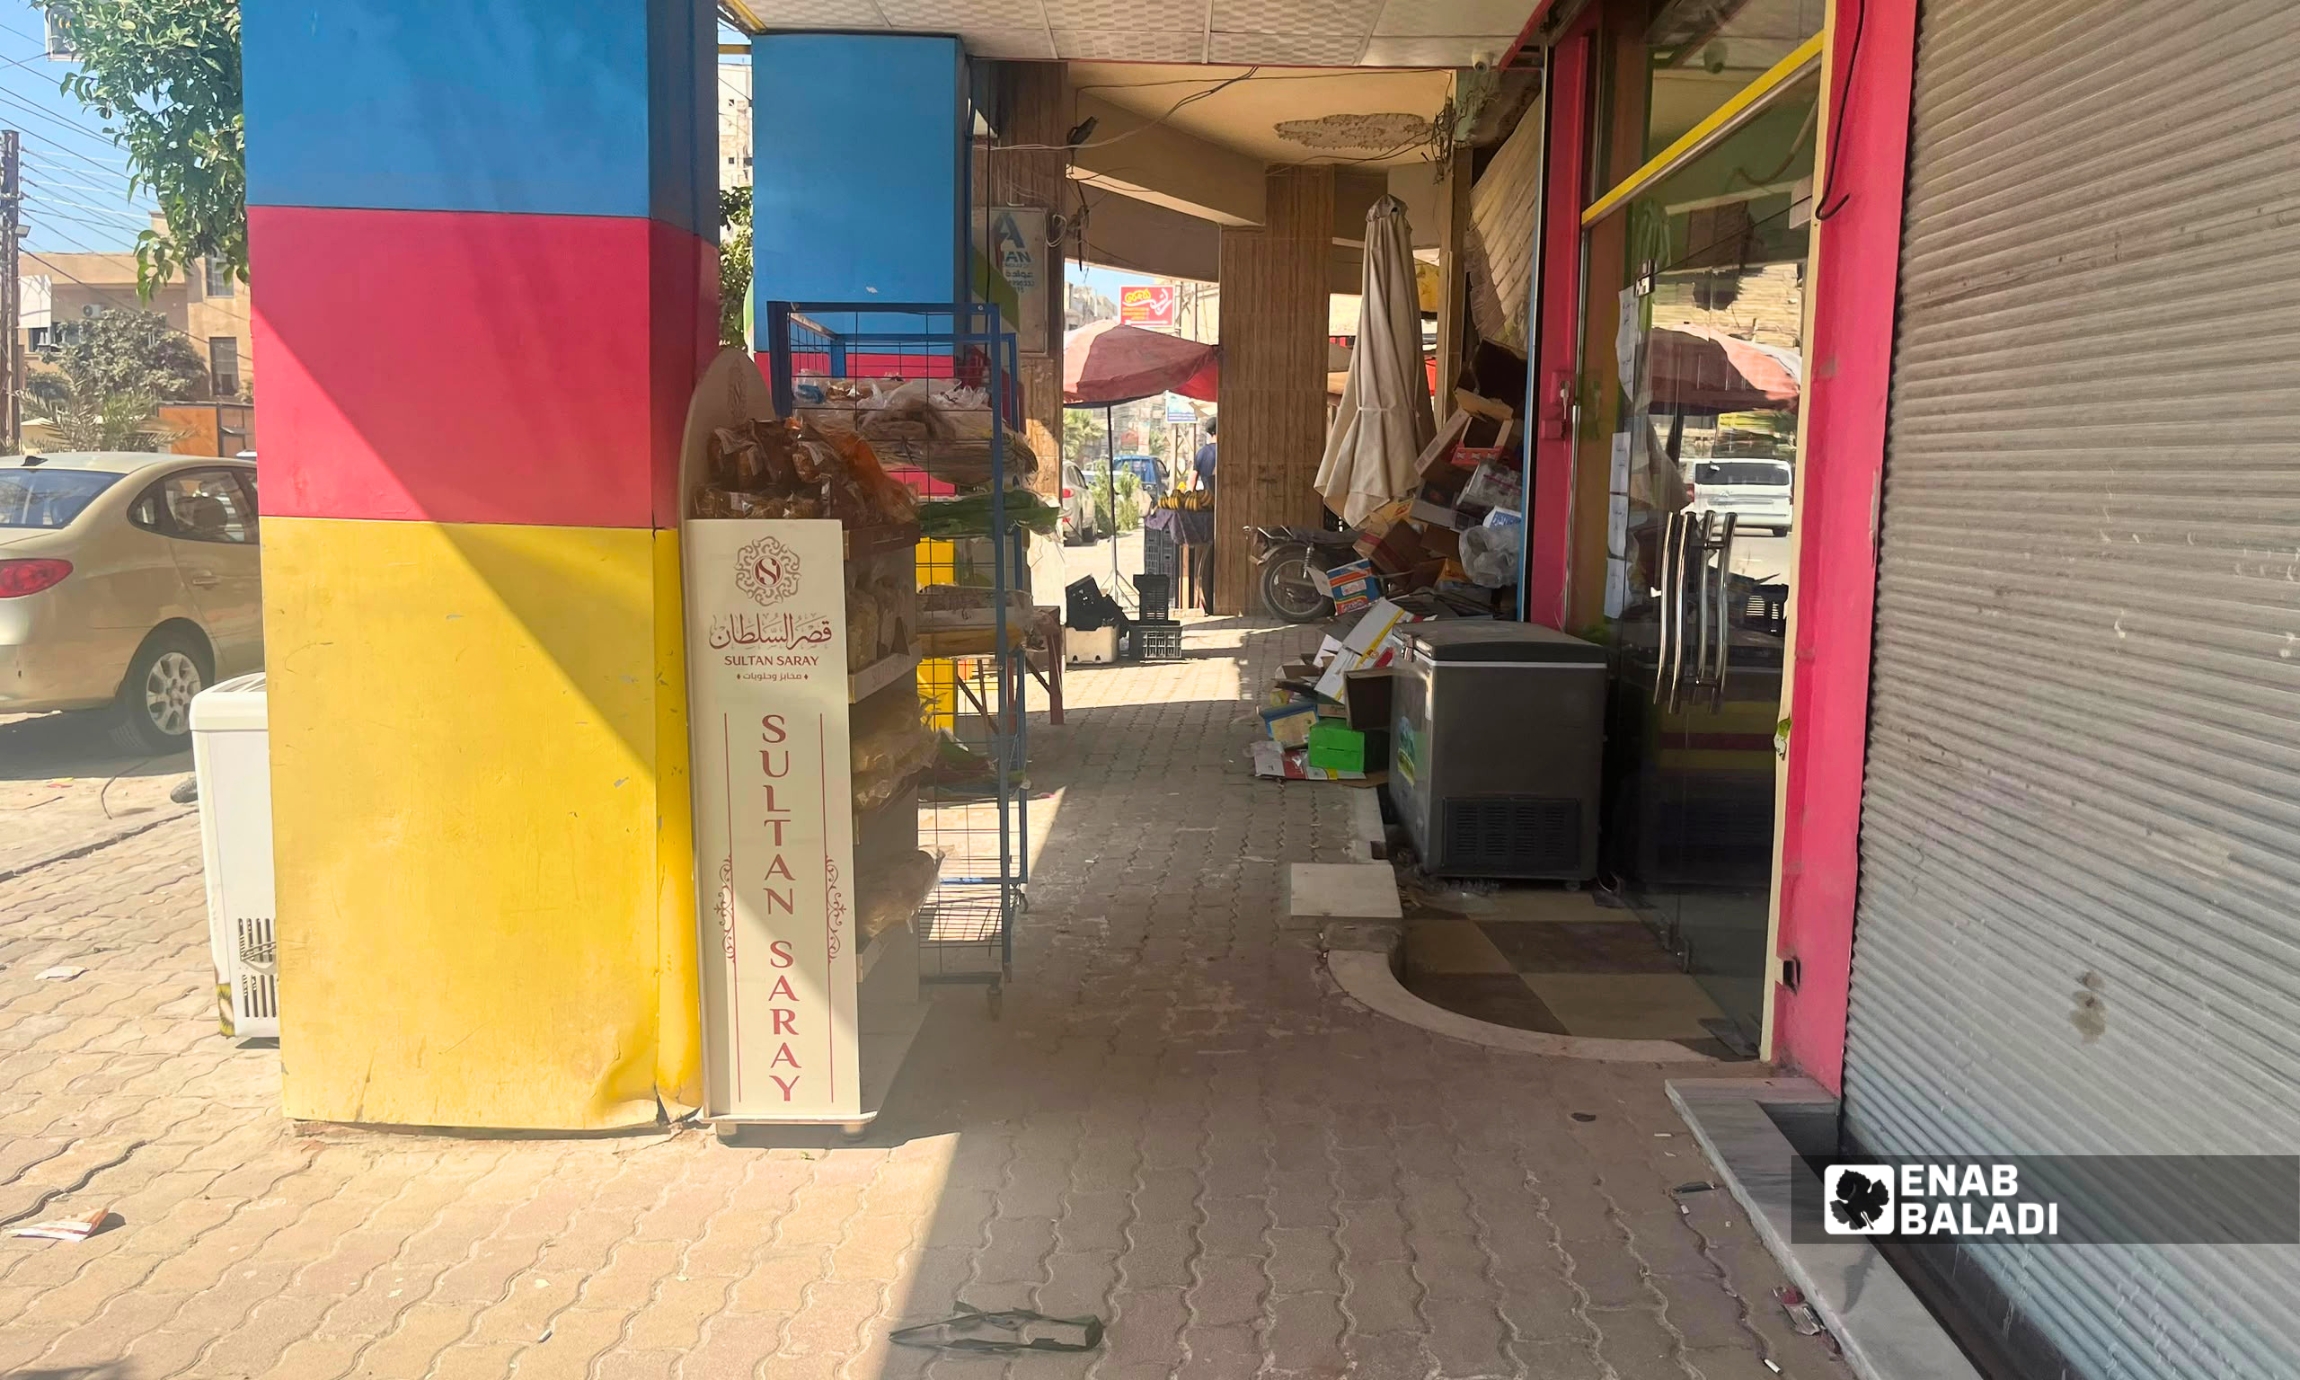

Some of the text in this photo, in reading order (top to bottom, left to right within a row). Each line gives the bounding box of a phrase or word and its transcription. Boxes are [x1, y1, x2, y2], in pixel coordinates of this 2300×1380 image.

[785, 620, 833, 651] قصر
[724, 655, 820, 667] SULTAN SARAY
[742, 672, 803, 682] مخابز وحلويات
[758, 713, 803, 1102] SULTAN SARAY
